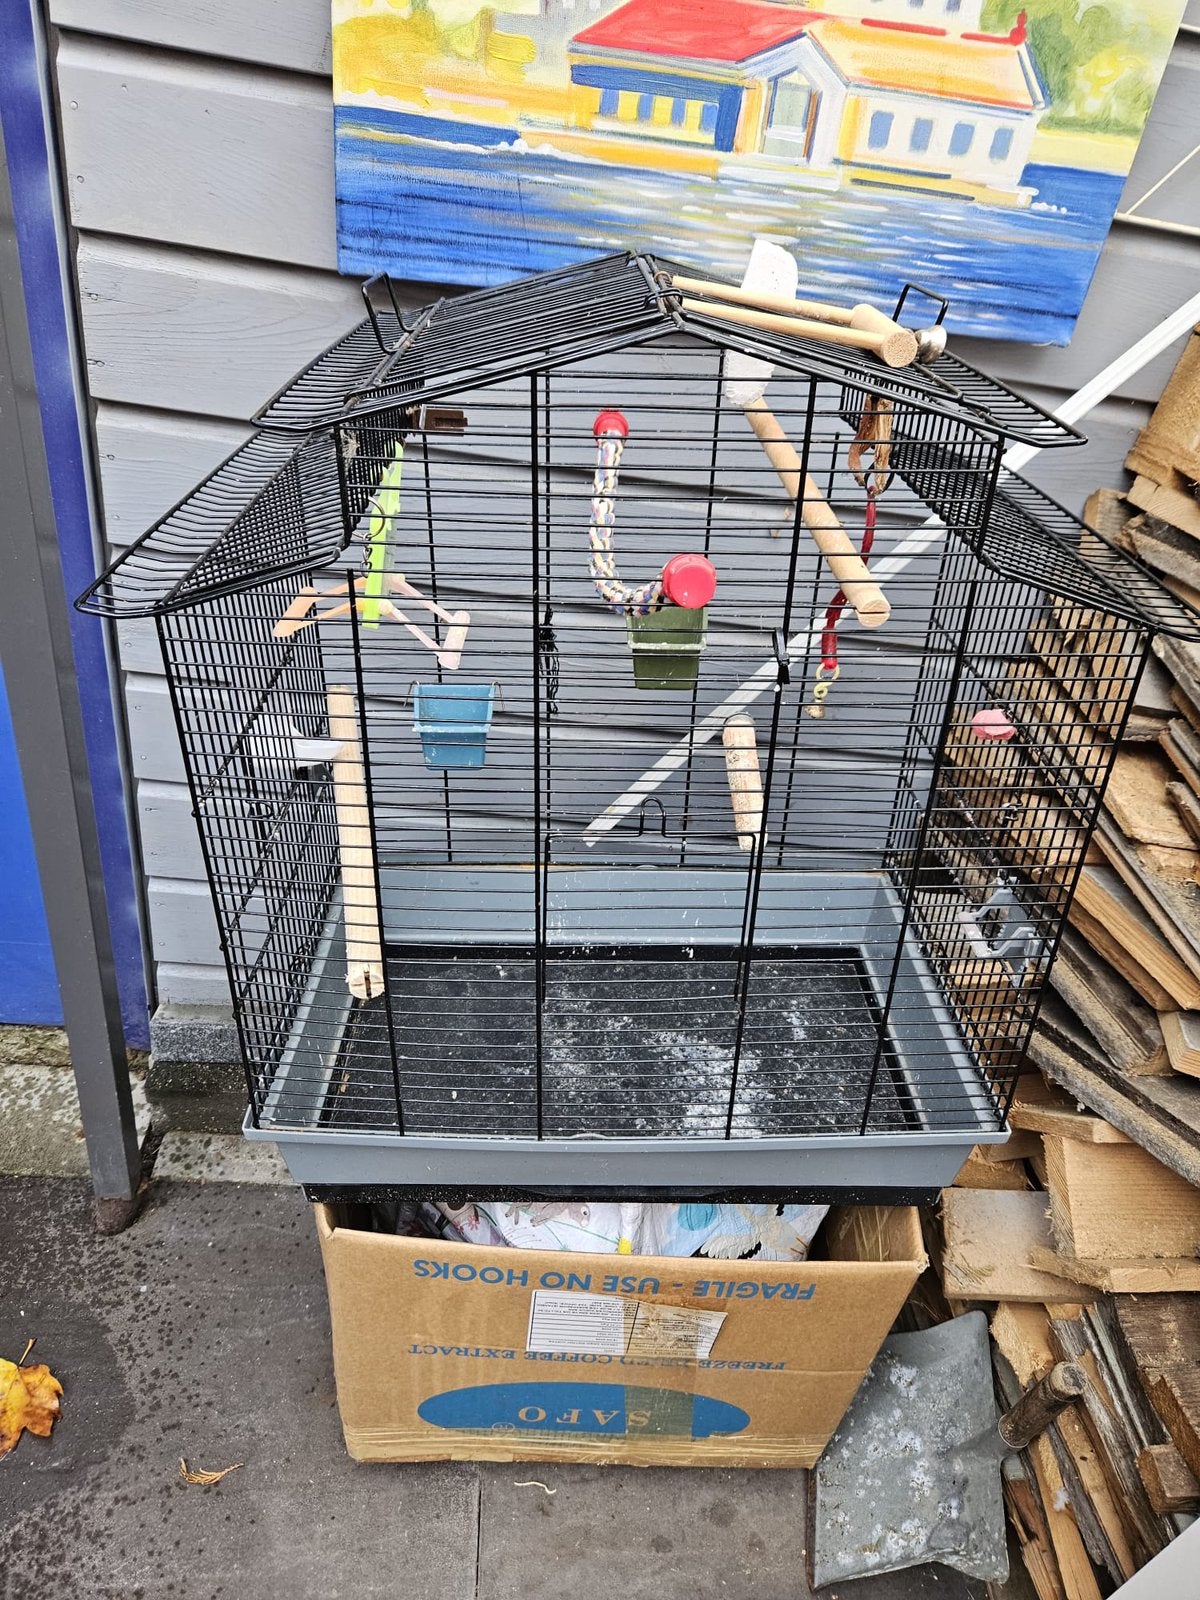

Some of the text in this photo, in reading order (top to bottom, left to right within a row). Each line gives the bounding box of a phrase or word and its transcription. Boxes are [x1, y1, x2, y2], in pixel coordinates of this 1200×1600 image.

[414, 1259, 528, 1286] HOOKS
[539, 1272, 591, 1291] NO
[604, 1275, 660, 1295] USE
[694, 1281, 815, 1300] FRAGILE
[408, 1343, 516, 1360] EXTRACT
[523, 1350, 613, 1364] COFFEE
[696, 1359, 786, 1371] FREEZE
[517, 1405, 651, 1427] SAFO
